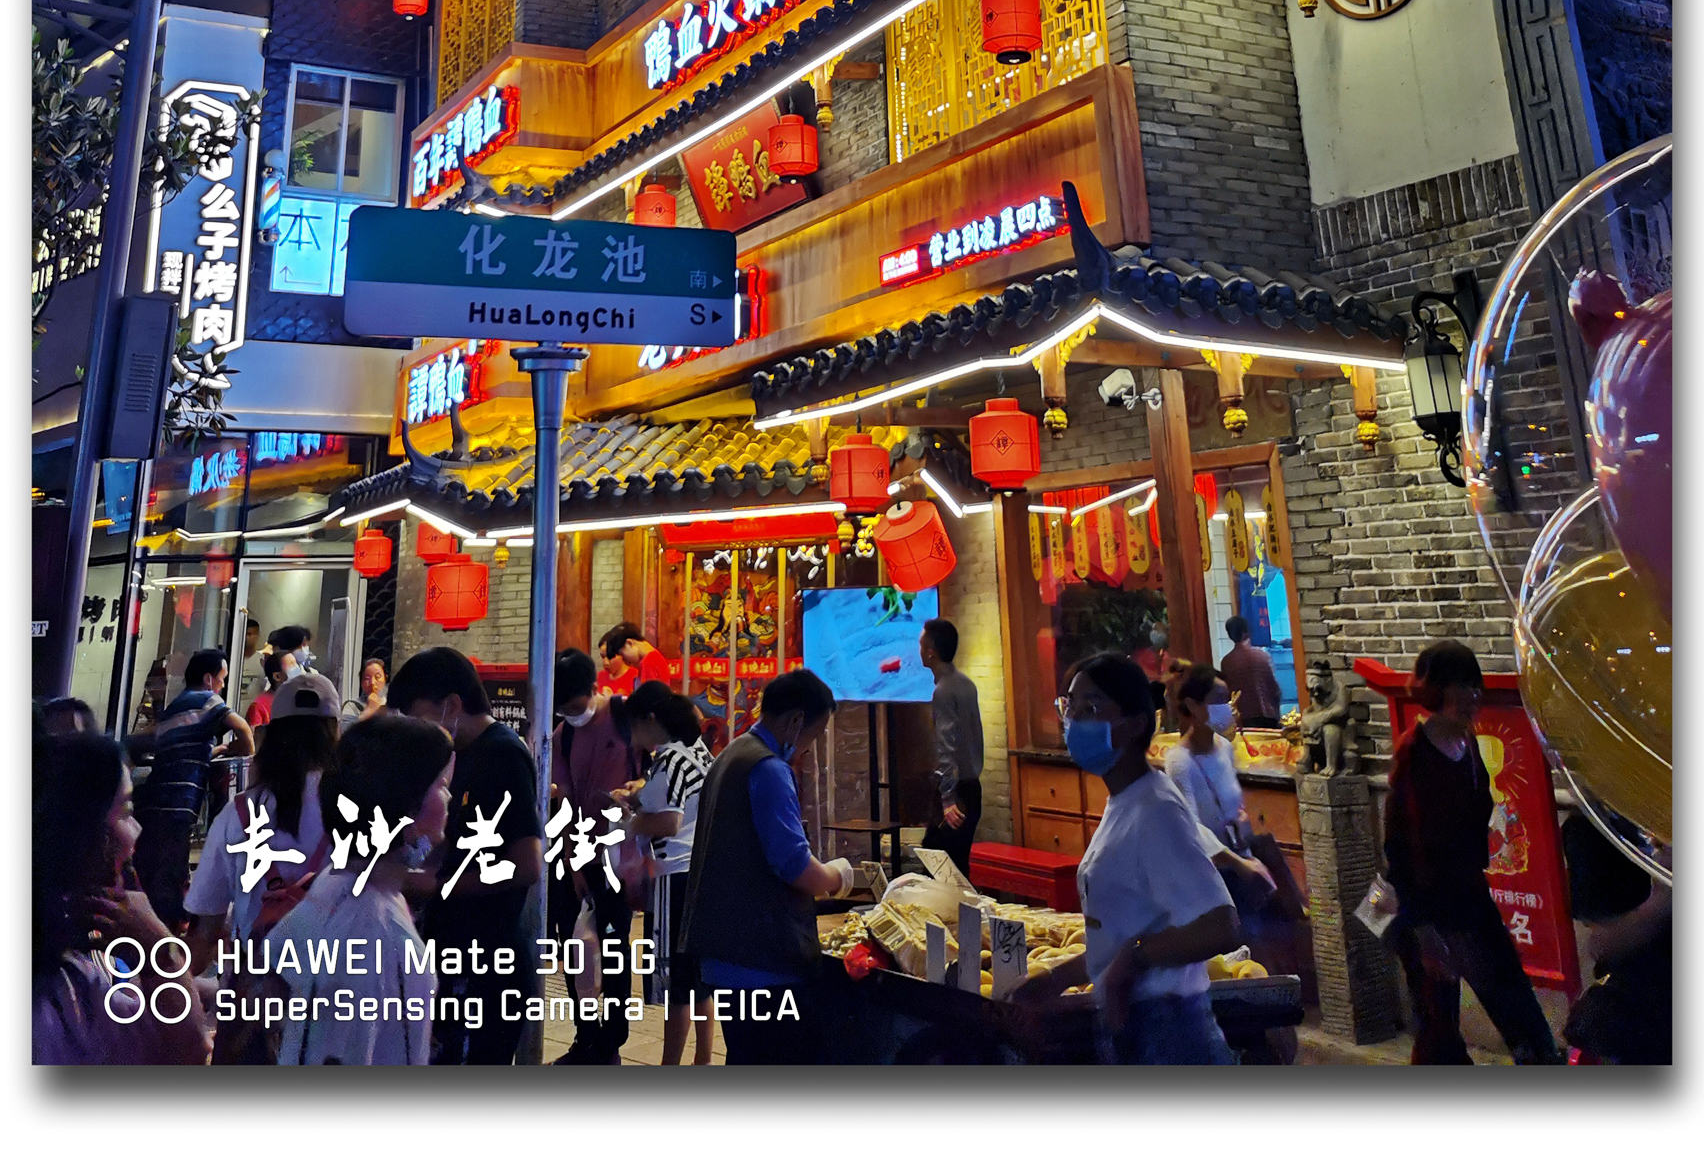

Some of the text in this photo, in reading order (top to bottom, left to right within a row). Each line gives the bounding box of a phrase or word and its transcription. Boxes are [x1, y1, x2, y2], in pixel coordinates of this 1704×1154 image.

[929, 196, 1056, 268] 营业到凌晨四点
[458, 224, 646, 284] 化龙池
[689, 270, 707, 290] 南
[469, 302, 635, 333] HuaLongChi
[689, 303, 706, 326] S
